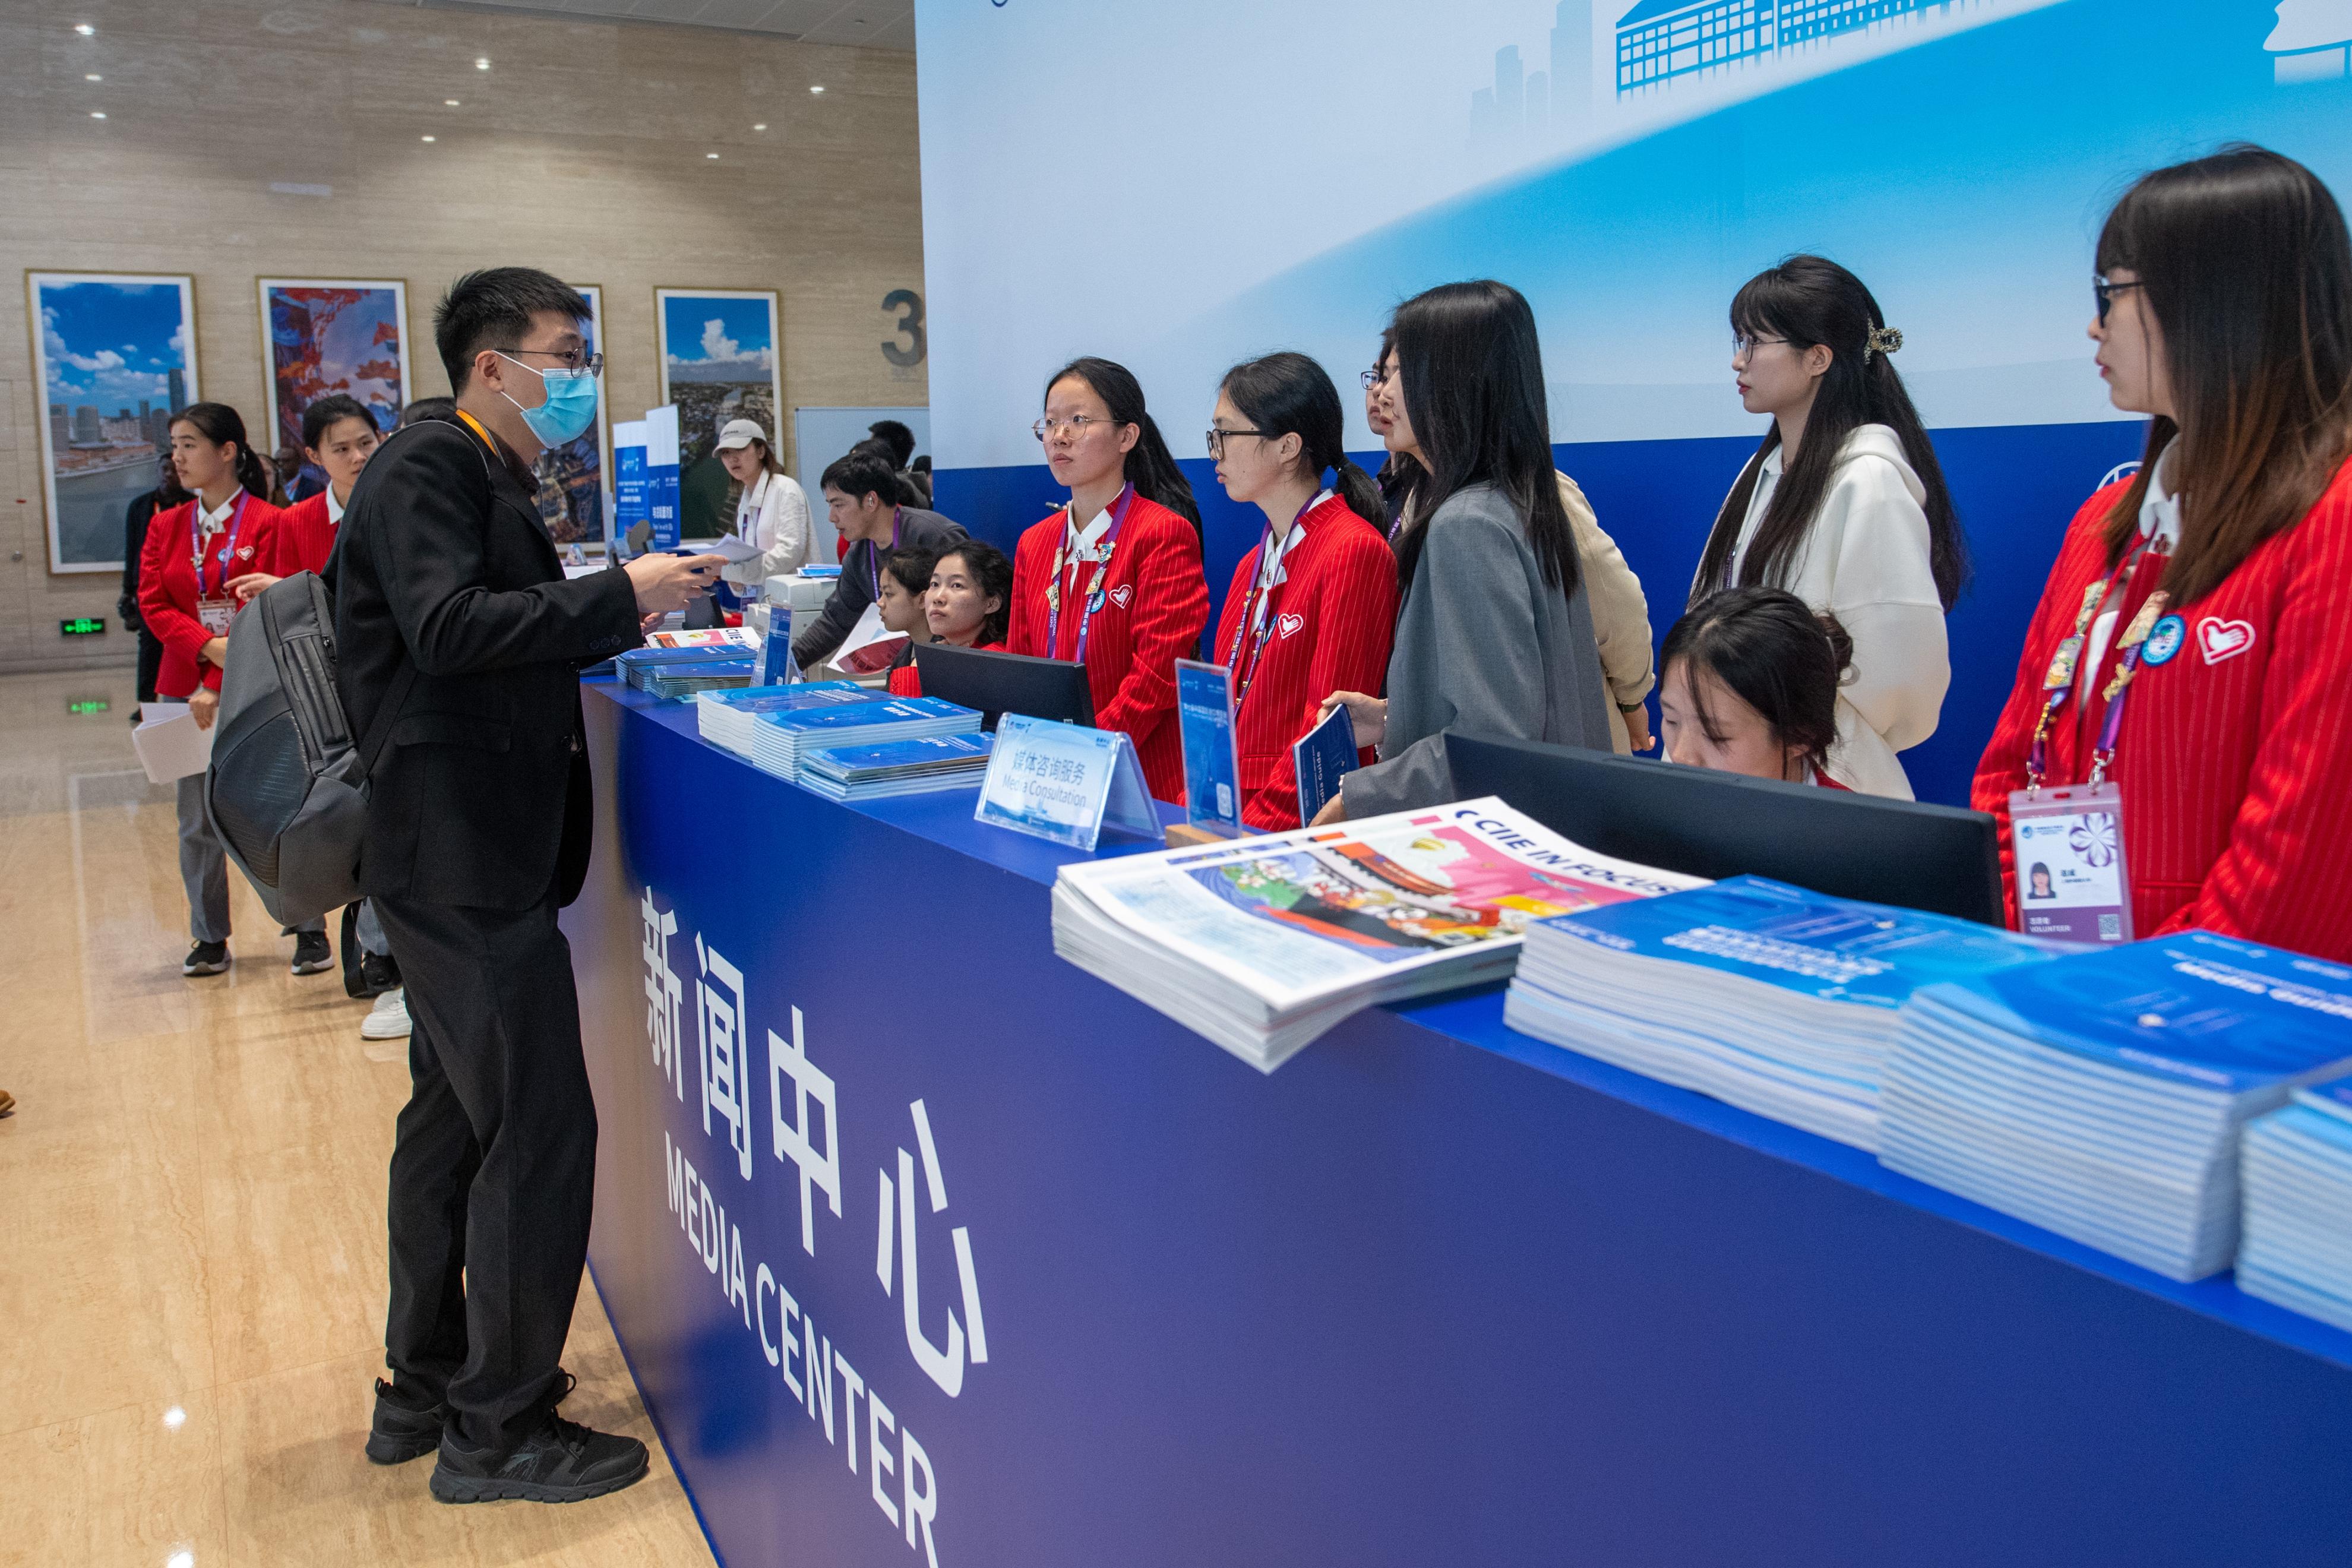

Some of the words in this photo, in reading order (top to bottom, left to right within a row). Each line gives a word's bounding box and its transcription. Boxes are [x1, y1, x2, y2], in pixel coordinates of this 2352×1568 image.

[881, 289, 927, 366] 3
[725, 628, 743, 640] CIIE
[1012, 749, 1085, 785] 媒体咨询服务
[1029, 780, 1086, 807] Consultation
[1474, 818, 1536, 851] CIIE
[1527, 849, 1571, 865] IN
[1563, 863, 1681, 894] FOCUS
[2029, 924, 2072, 933] VOLUNTEER
[641, 885, 988, 1398] 新闻中心
[665, 1130, 751, 1331] MEDIA
[756, 1262, 939, 1568] CENTER
